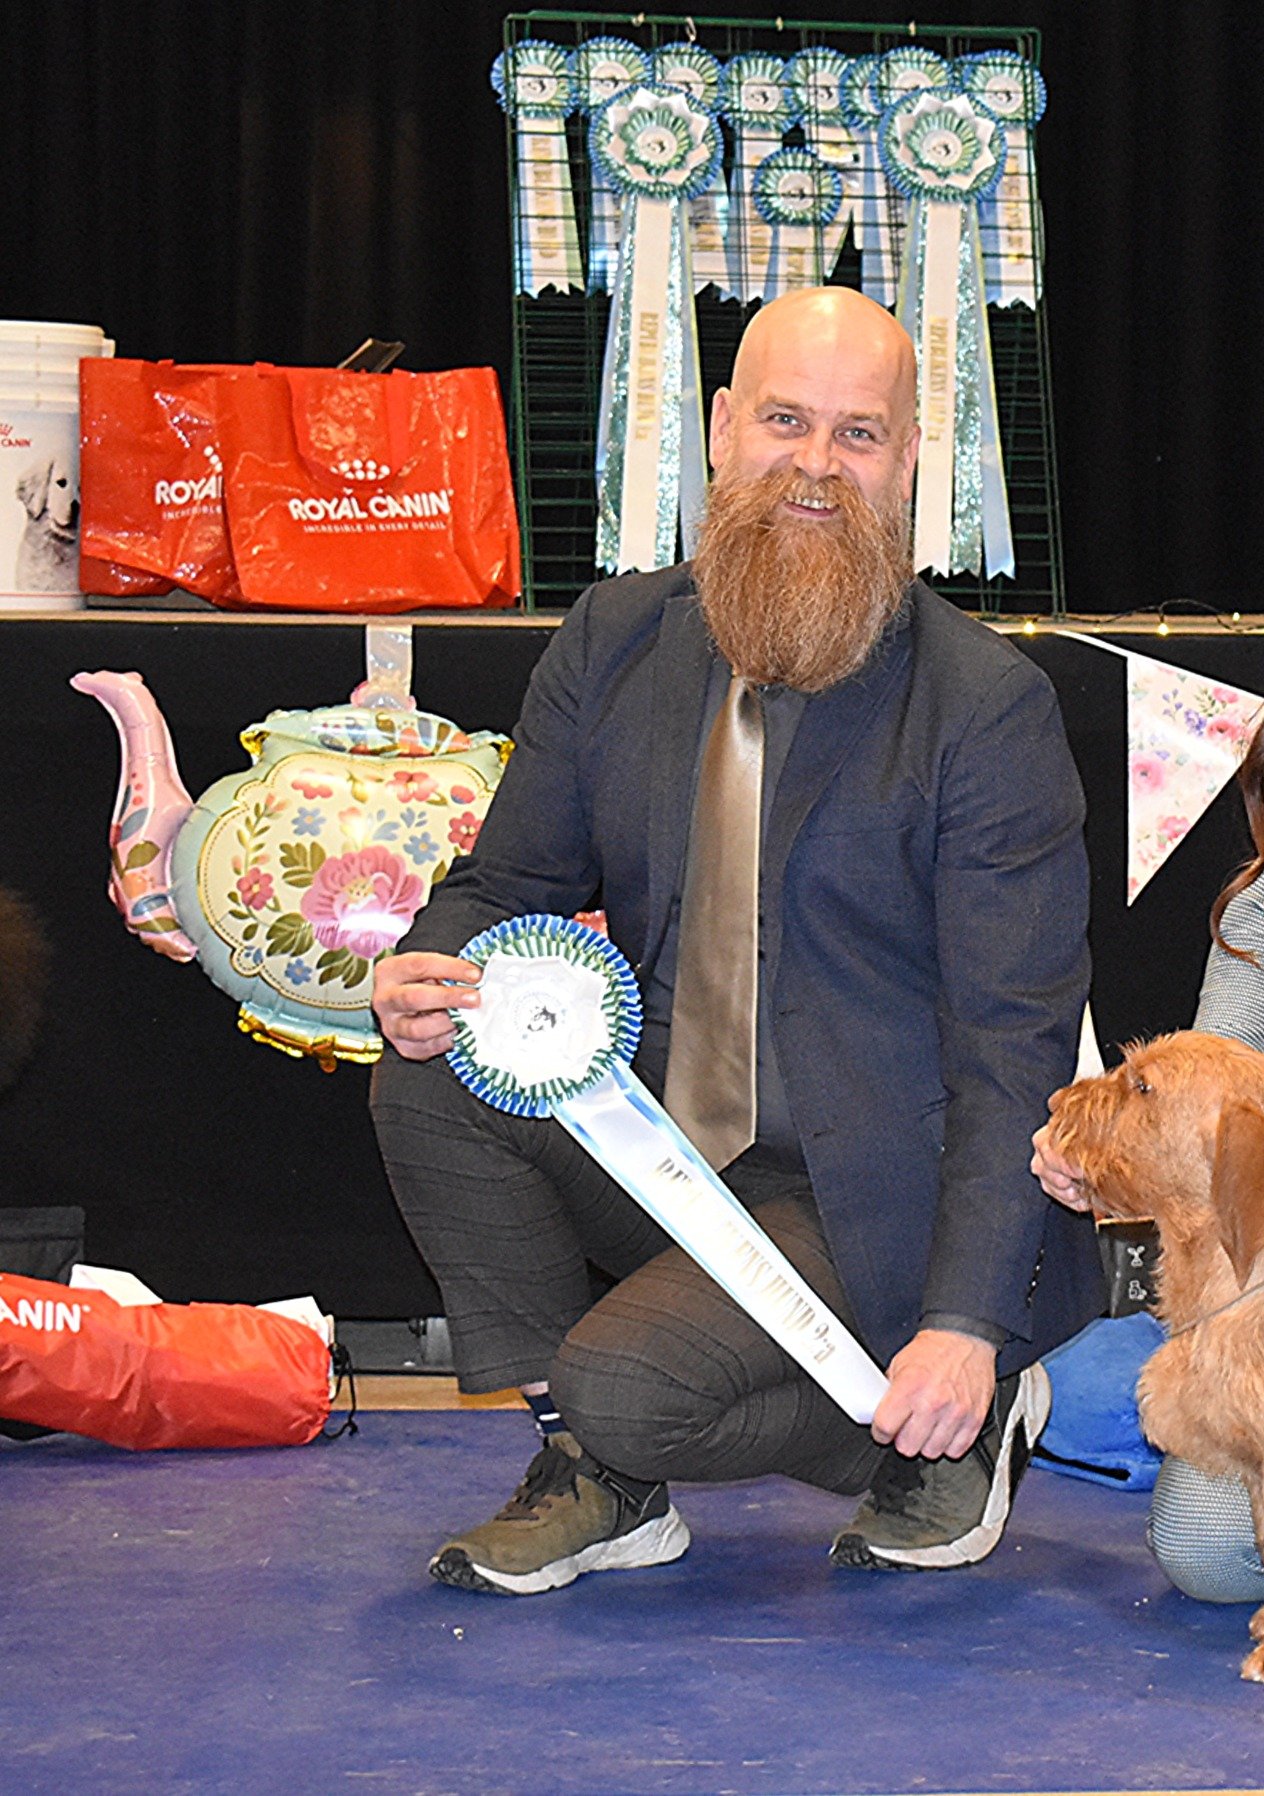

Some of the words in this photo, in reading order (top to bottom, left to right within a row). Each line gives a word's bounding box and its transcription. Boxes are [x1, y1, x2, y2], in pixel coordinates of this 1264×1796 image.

[288, 497, 368, 521] ROYAL
[368, 489, 450, 519] CANIN
[303, 524, 363, 533] INCREDIBLE
[365, 523, 377, 532] IN
[379, 522, 409, 531] EVERY
[411, 521, 446, 530] DETAIL
[0, 1296, 81, 1333] ANIN
